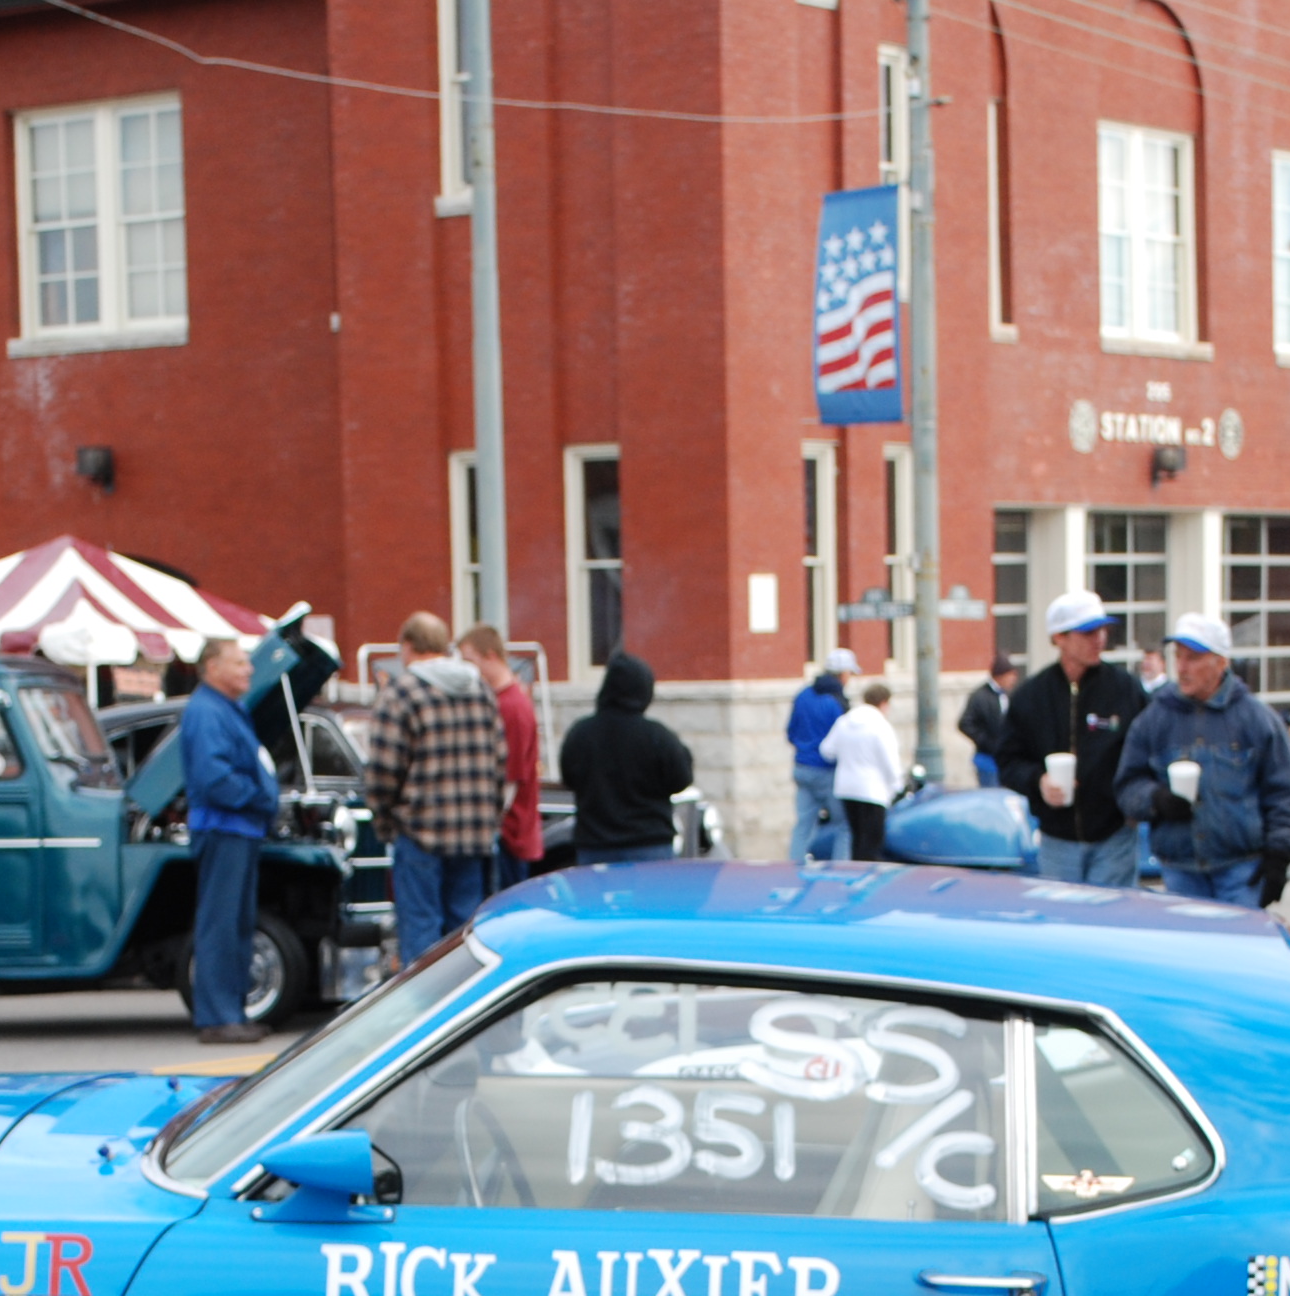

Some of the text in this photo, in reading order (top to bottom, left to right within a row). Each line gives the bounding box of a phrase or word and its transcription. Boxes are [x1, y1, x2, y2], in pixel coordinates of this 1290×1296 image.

[1101, 412, 1183, 445] STATION
[1202, 417, 1216, 447] 2
[567, 1083, 797, 1186] 1351
